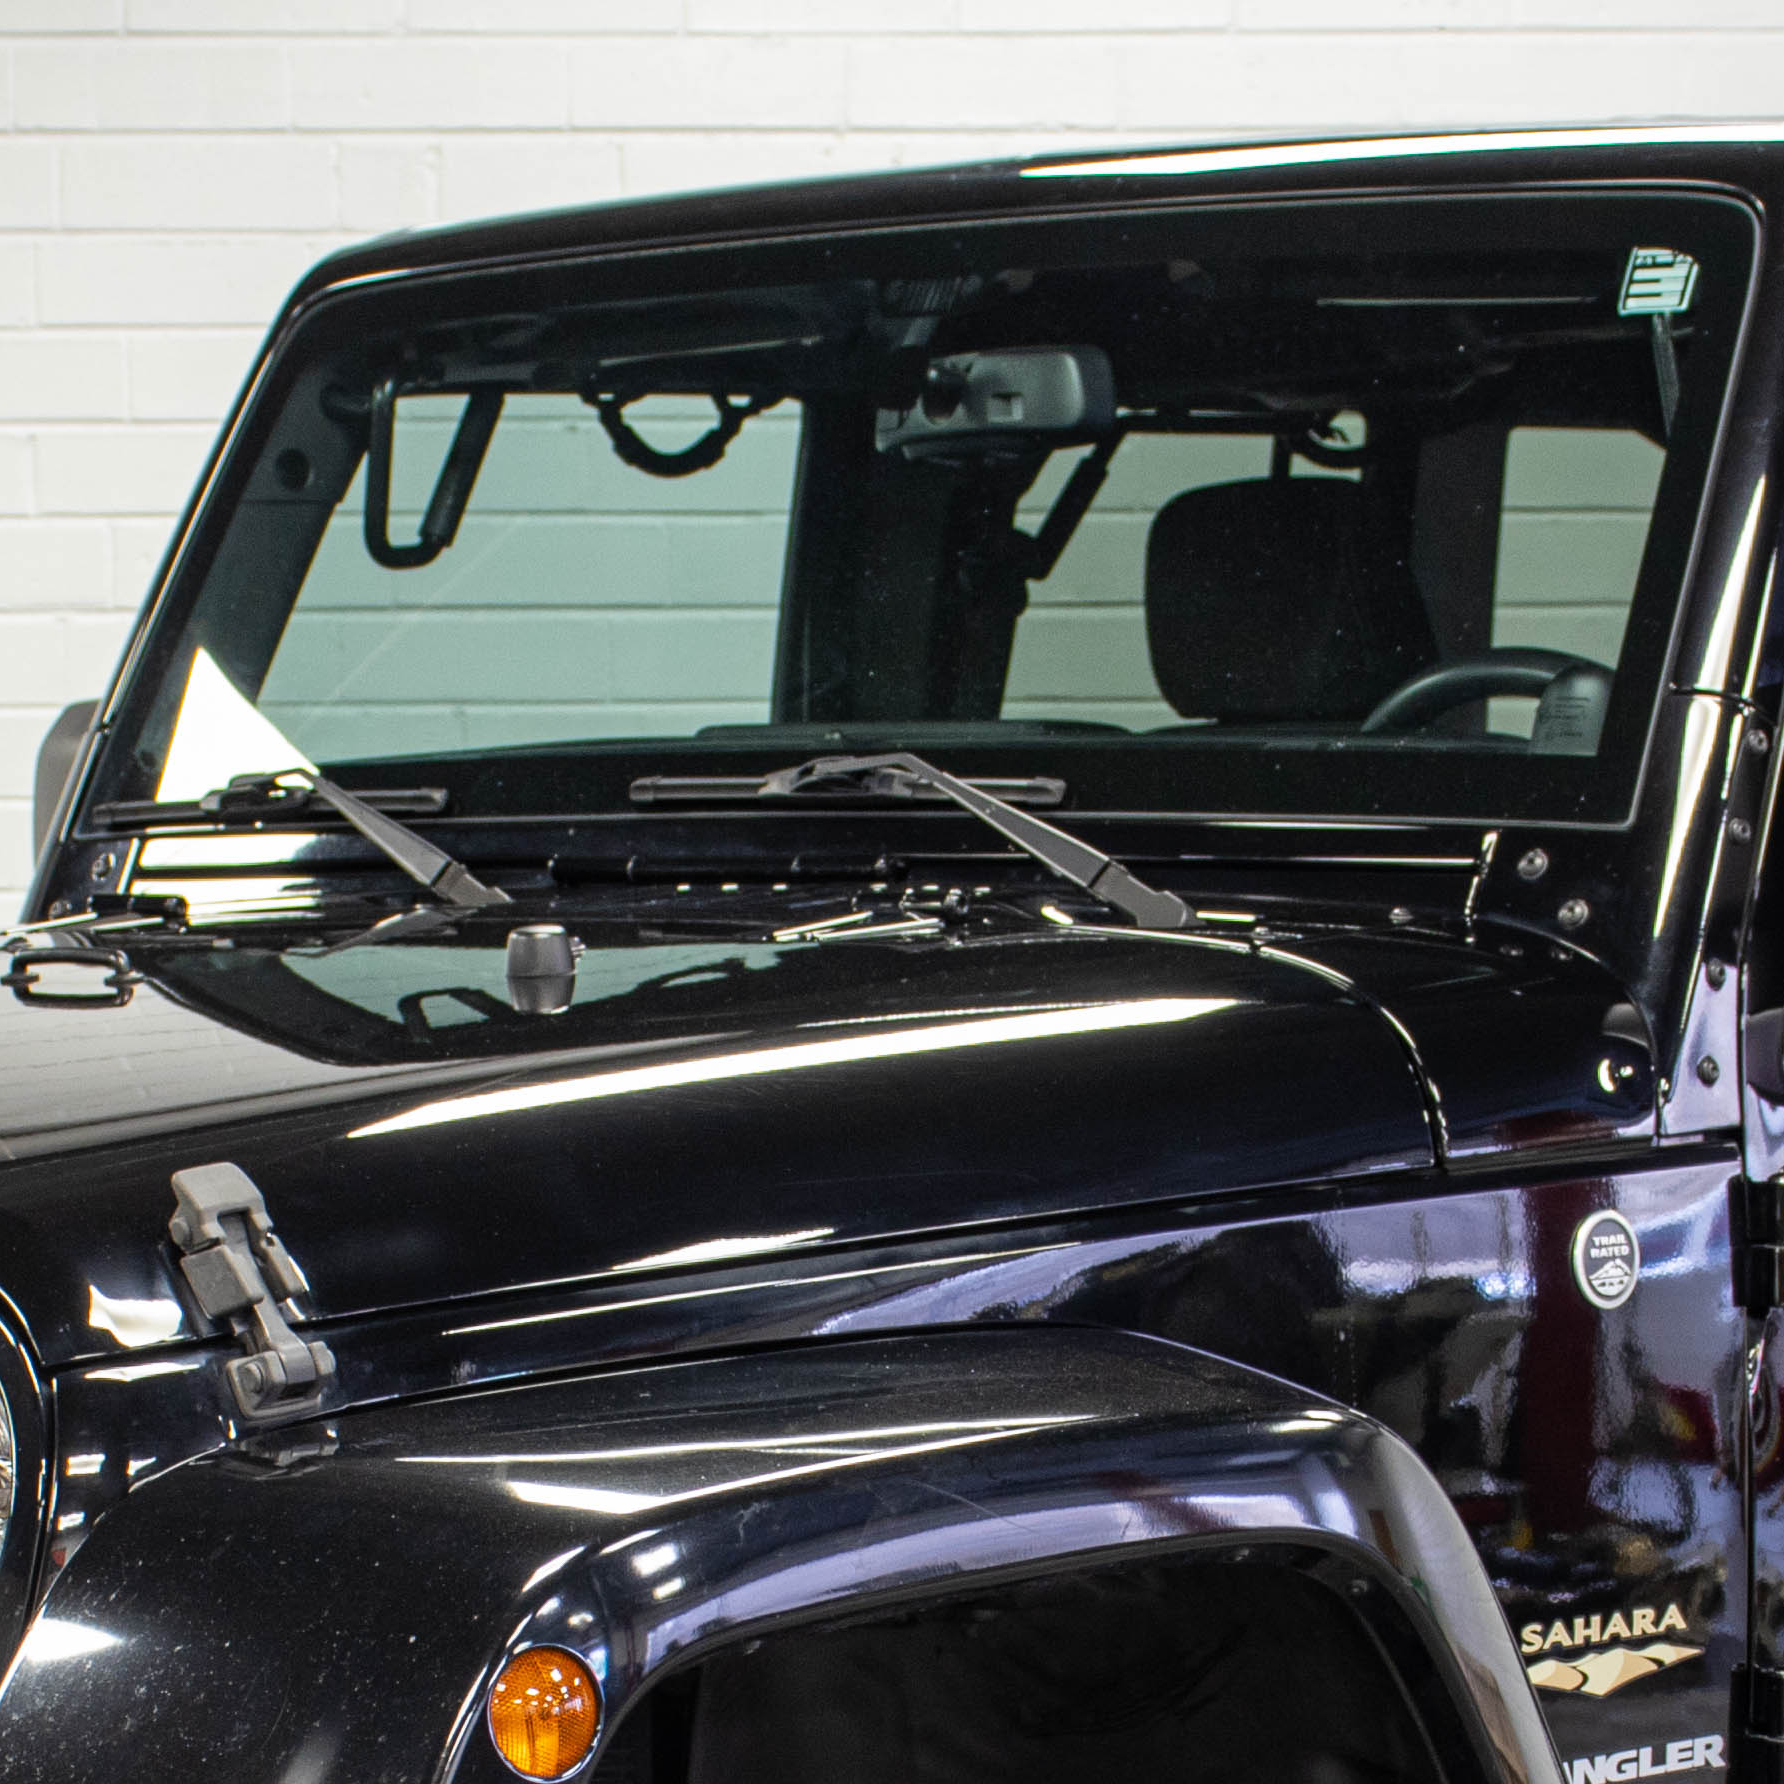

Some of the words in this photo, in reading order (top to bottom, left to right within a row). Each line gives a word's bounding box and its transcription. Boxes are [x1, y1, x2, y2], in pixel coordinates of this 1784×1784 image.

[1592, 1233, 1626, 1247] TRAIL
[1590, 1245, 1630, 1259] RATED
[1520, 1603, 1688, 1654] SAHARA
